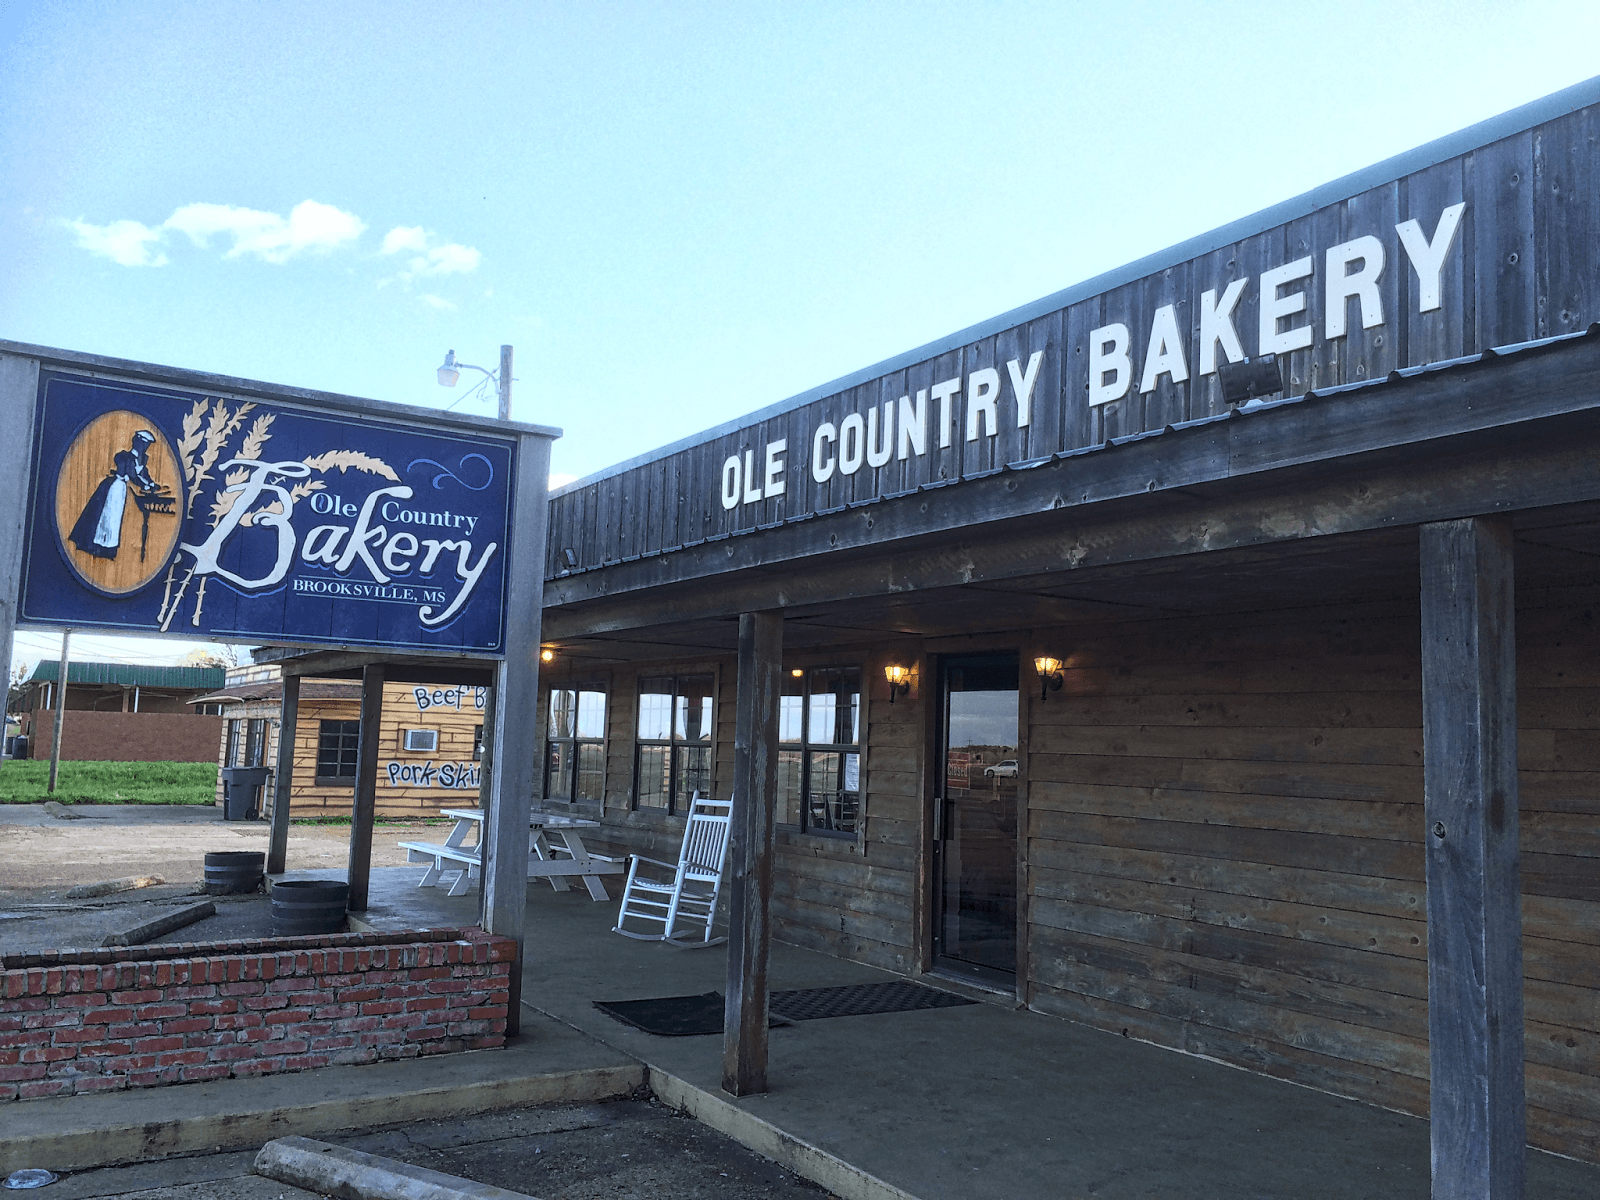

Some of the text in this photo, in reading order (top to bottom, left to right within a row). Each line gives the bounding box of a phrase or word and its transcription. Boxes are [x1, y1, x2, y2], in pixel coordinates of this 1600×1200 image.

[720, 202, 1467, 511] OLE COUNTRY BAKERY
[310, 492, 479, 535] Ole Country
[179, 459, 498, 625] Bakery
[292, 579, 446, 603] BROOKSVILLE, MS
[413, 685, 471, 711] Beef
[387, 761, 438, 786] Pork
